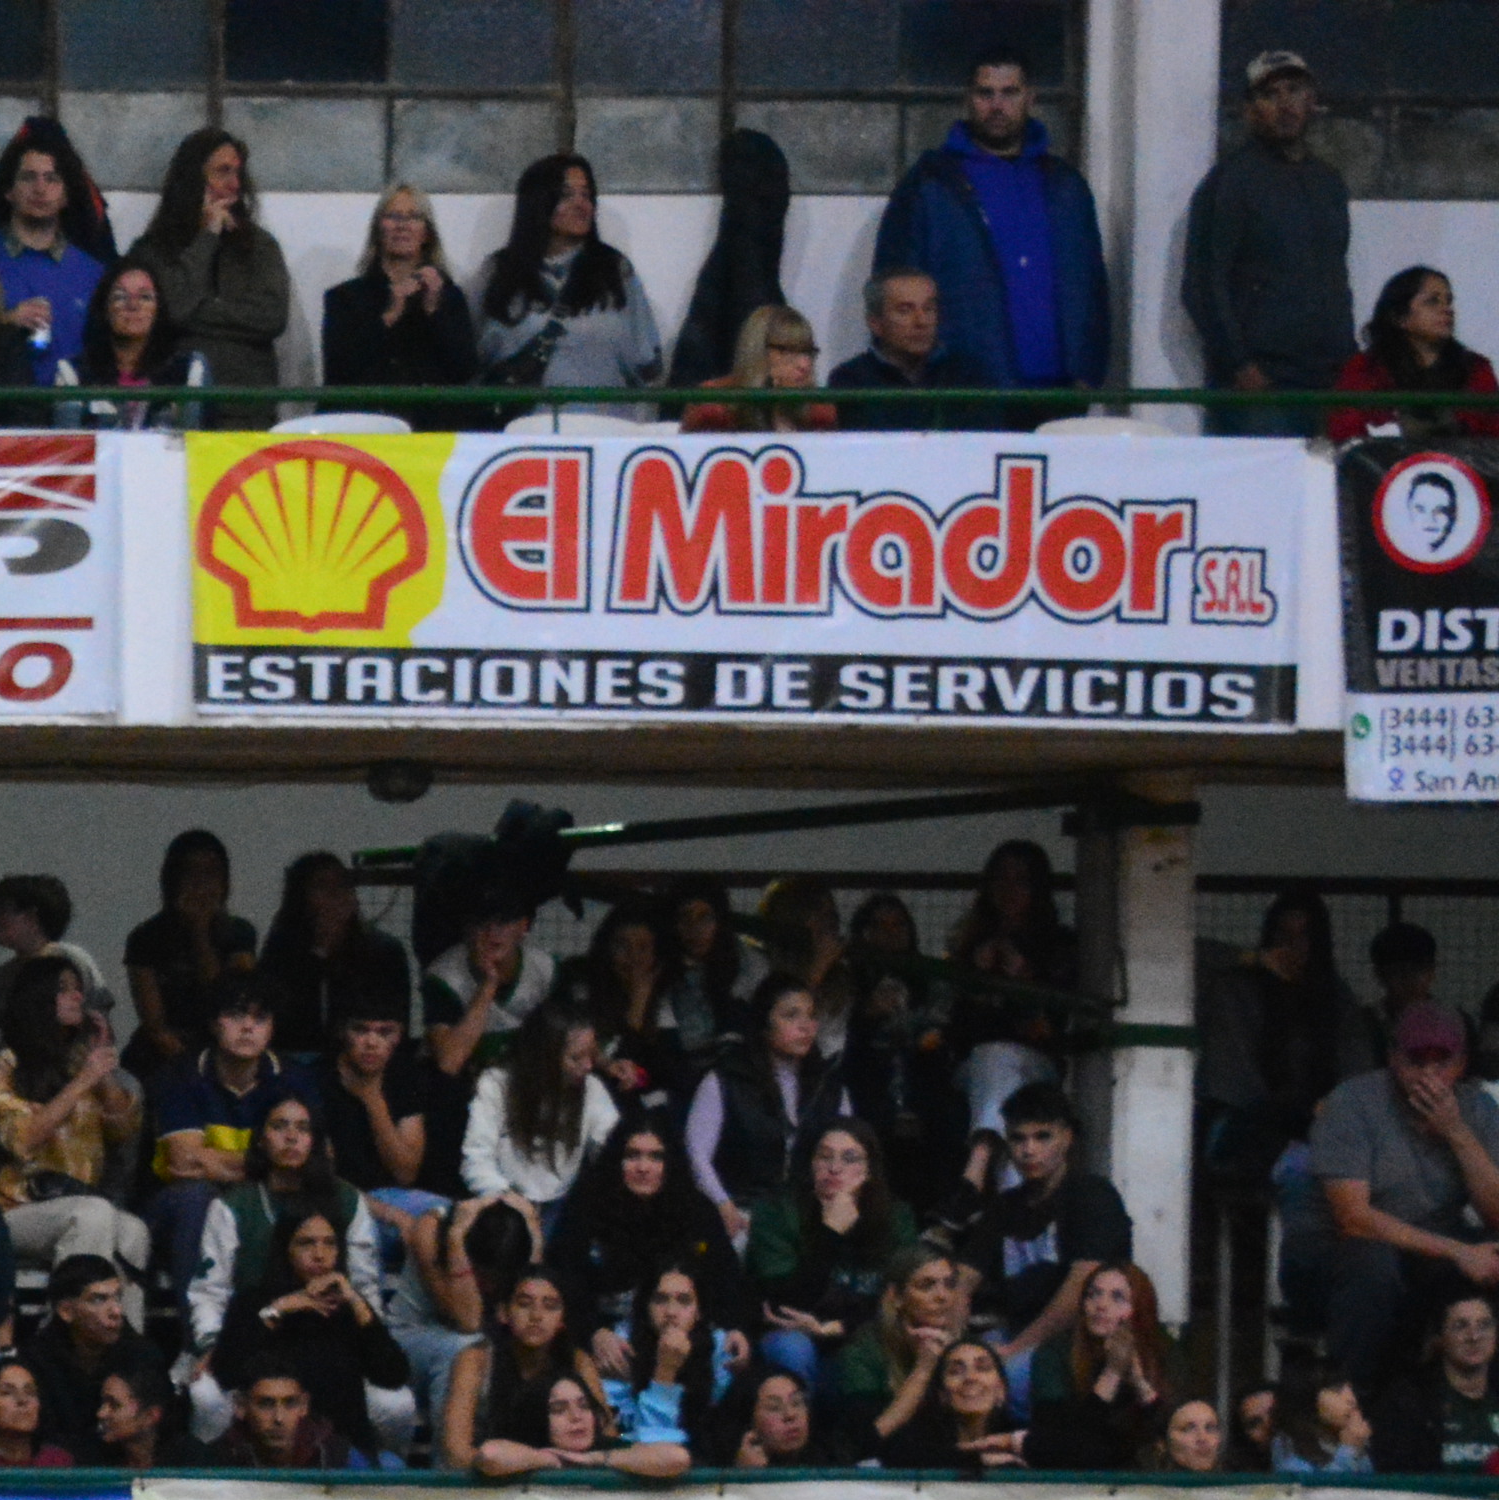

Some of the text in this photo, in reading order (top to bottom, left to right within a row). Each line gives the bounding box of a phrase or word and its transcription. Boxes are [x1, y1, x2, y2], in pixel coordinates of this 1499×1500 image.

[459, 447, 593, 613] El
[608, 444, 1195, 623] Mirador
[206, 654, 1256, 718] ESTACIONES DE SERVICIOS
